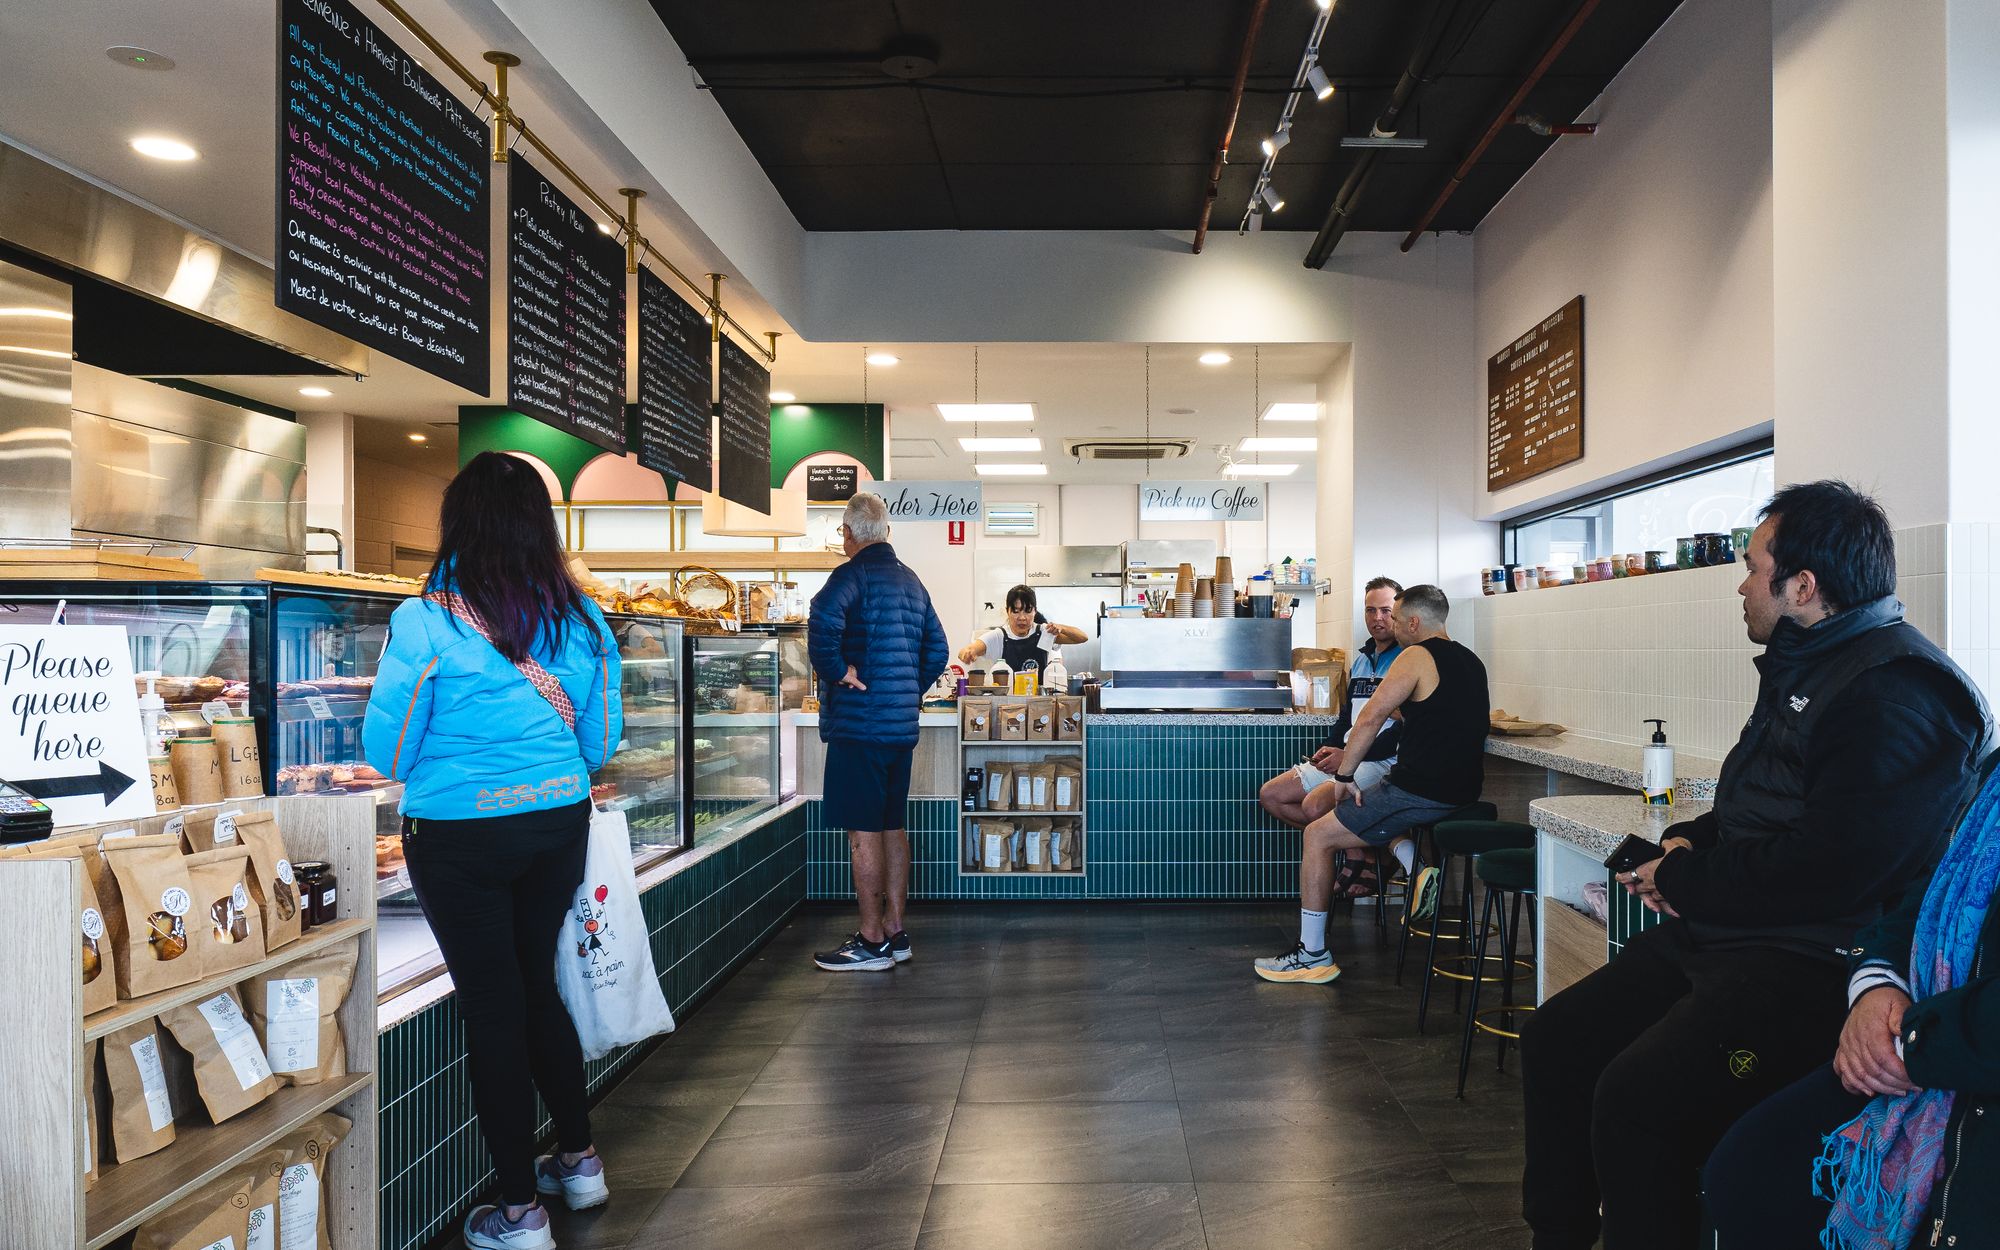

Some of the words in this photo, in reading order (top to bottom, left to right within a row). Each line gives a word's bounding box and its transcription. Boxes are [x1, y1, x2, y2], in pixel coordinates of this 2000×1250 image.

[290, 24, 300, 43] All
[319, 42, 341, 76] bread
[340, 86, 352, 106] We
[288, 121, 300, 143] We
[303, 131, 332, 166] Proudly
[327, 121, 351, 148] French
[288, 166, 315, 201] Valley
[324, 168, 341, 192] local
[289, 189, 322, 220] Pastries
[288, 219, 307, 243] Our
[290, 278, 317, 301] Merci
[319, 288, 331, 307] de
[374, 291, 387, 305] you
[928, 492, 979, 517] Here
[1144, 486, 1183, 513] Pick
[1185, 495, 1206, 514] up
[1211, 486, 1259, 518] Coffee
[0, 638, 113, 686] Please
[12, 691, 111, 736] queue
[33, 720, 105, 761] here
[156, 794, 176, 806] 8oz
[475, 783, 582, 811] CORTINA
